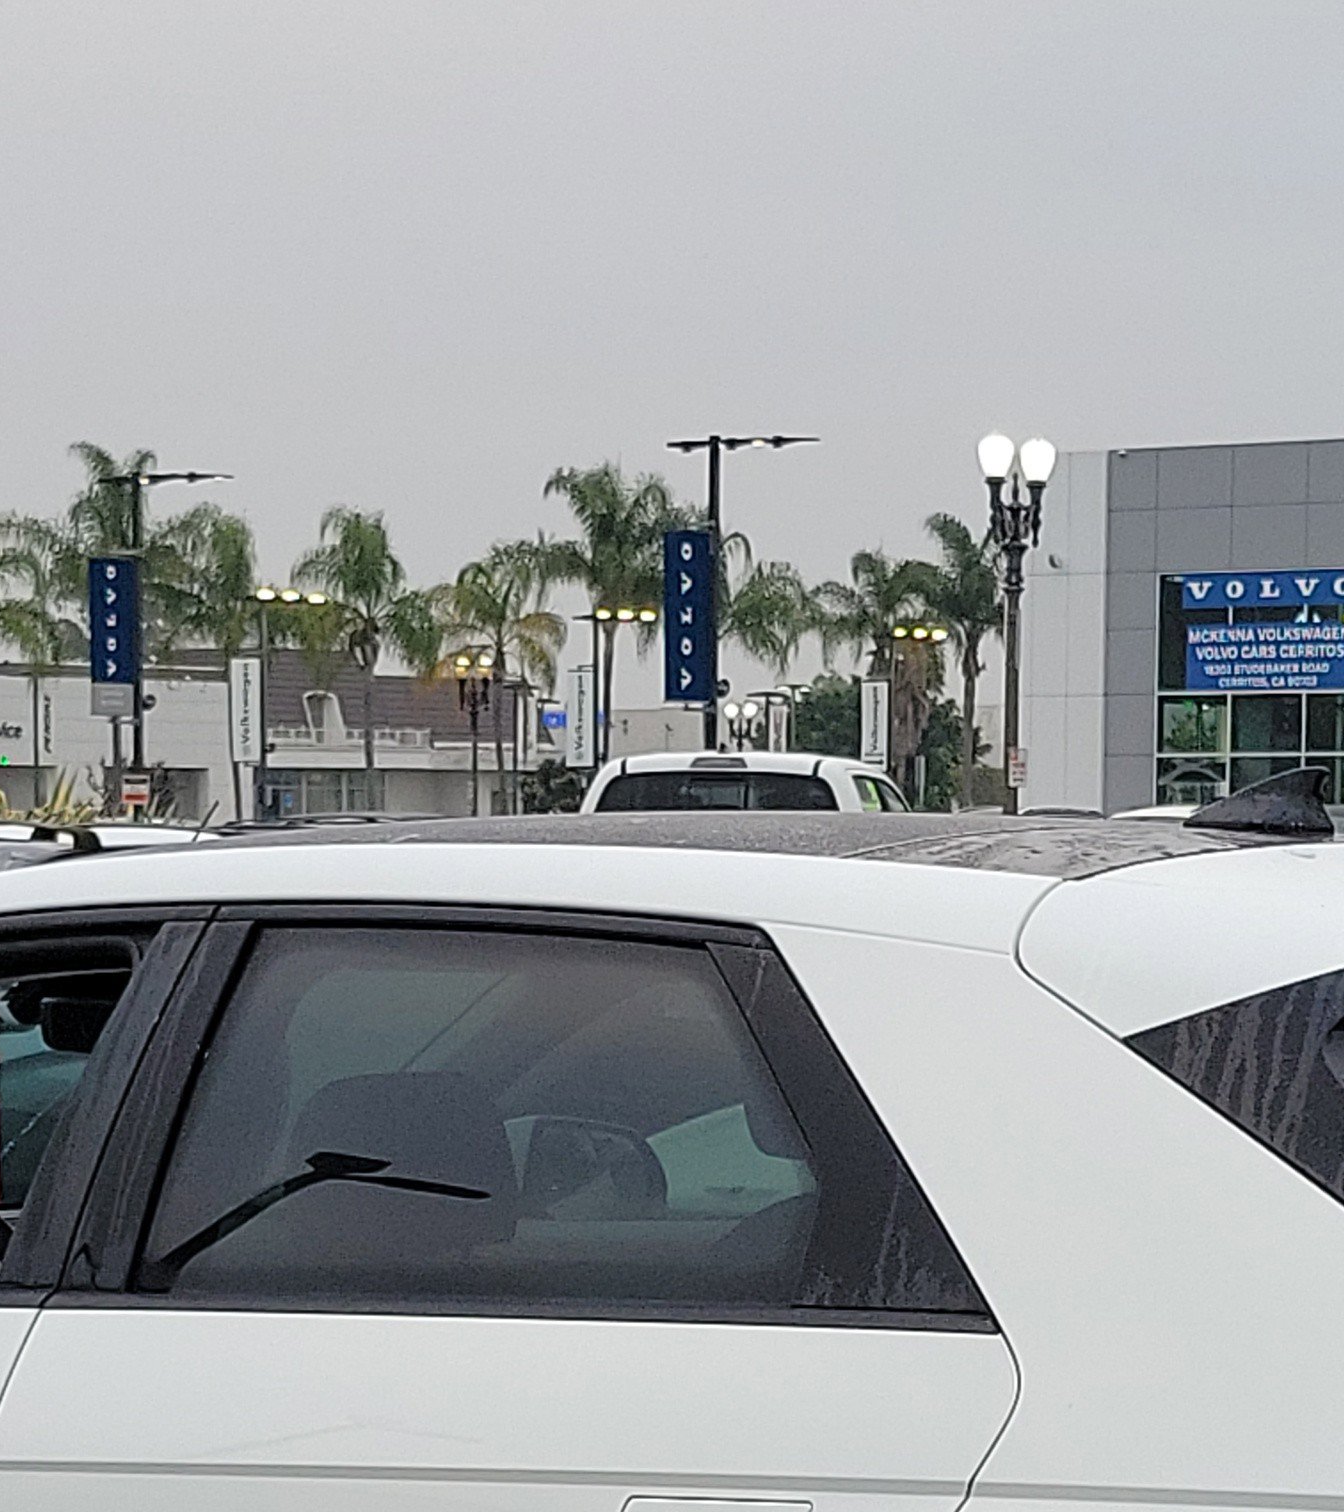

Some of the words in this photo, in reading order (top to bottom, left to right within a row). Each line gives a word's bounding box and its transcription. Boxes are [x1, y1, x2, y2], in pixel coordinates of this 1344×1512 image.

[680, 541, 693, 690] VOLVO
[1195, 647, 1238, 660] VOLVO
[1241, 645, 1276, 659] CARS
